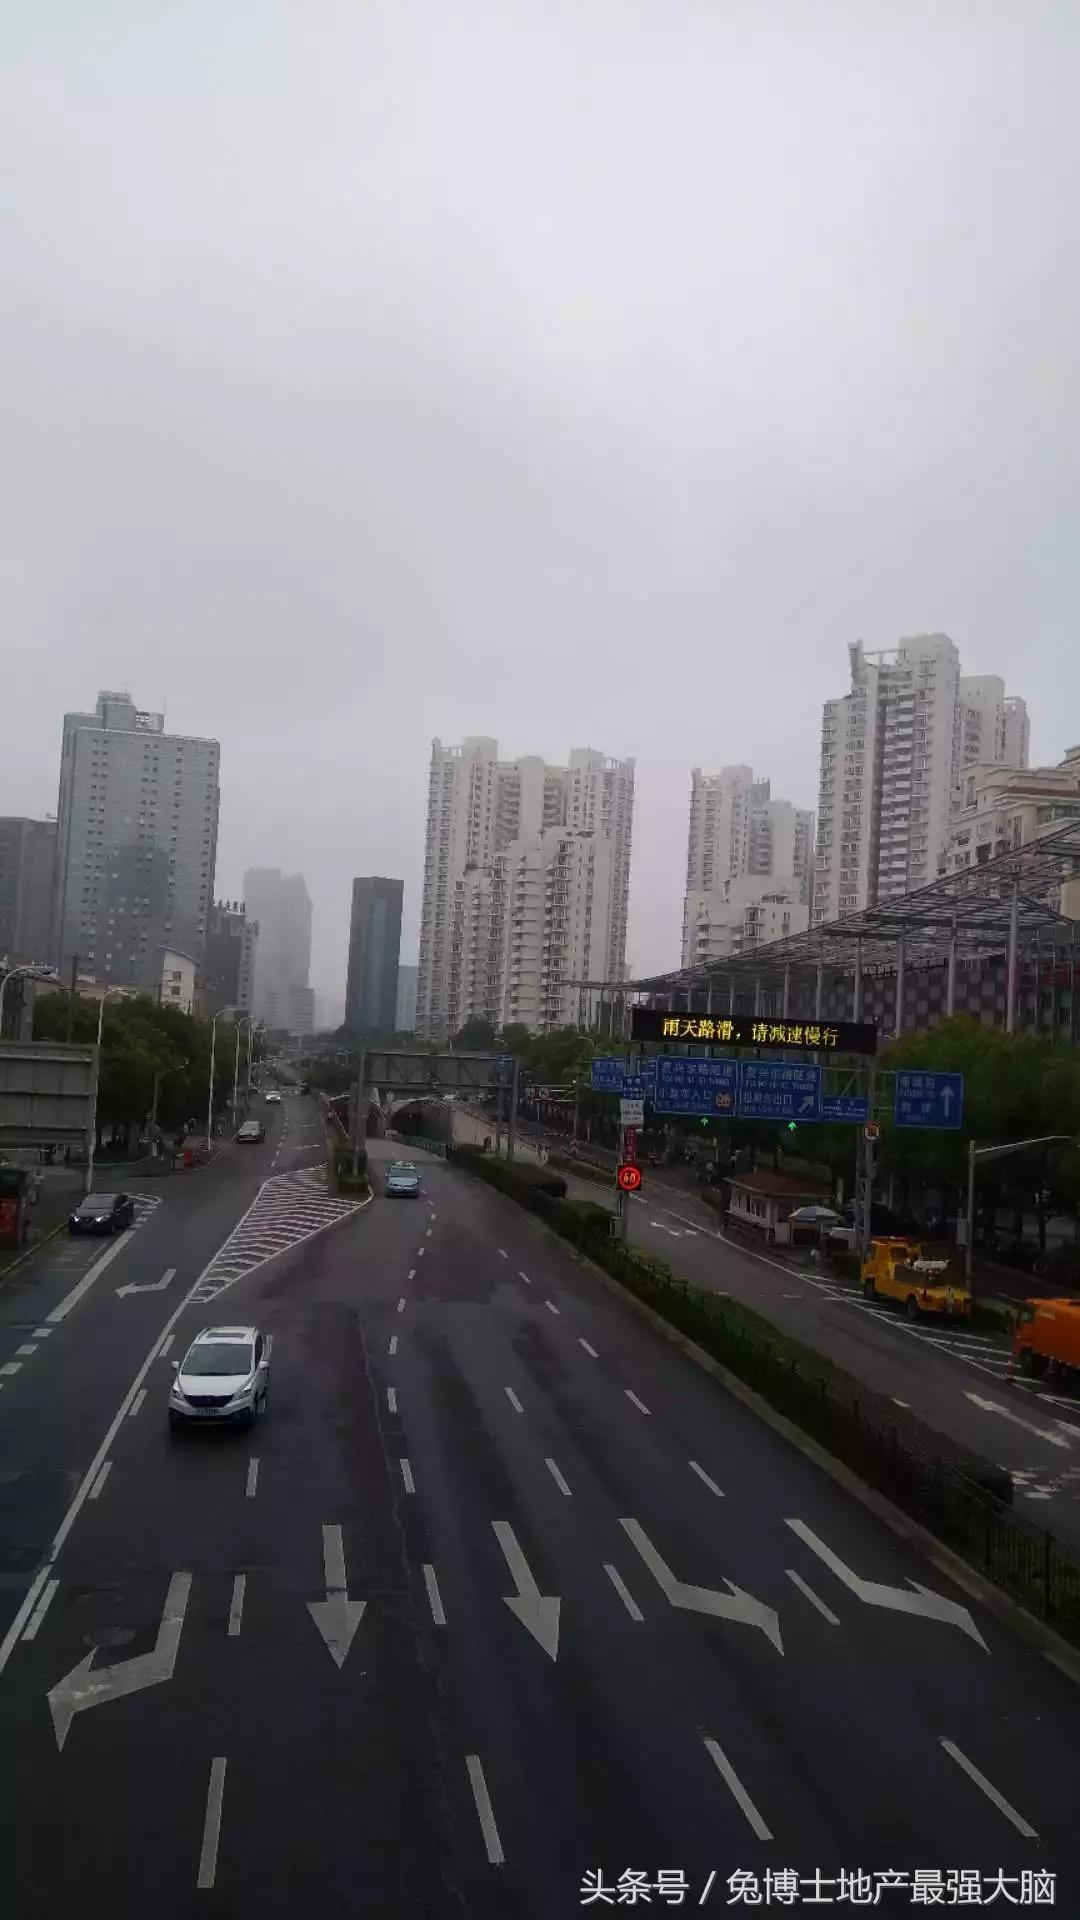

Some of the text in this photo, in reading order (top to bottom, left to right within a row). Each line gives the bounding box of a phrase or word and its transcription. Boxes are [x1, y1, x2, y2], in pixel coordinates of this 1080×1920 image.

[662, 1018, 840, 1047] 雨天路滑，请减速慢行
